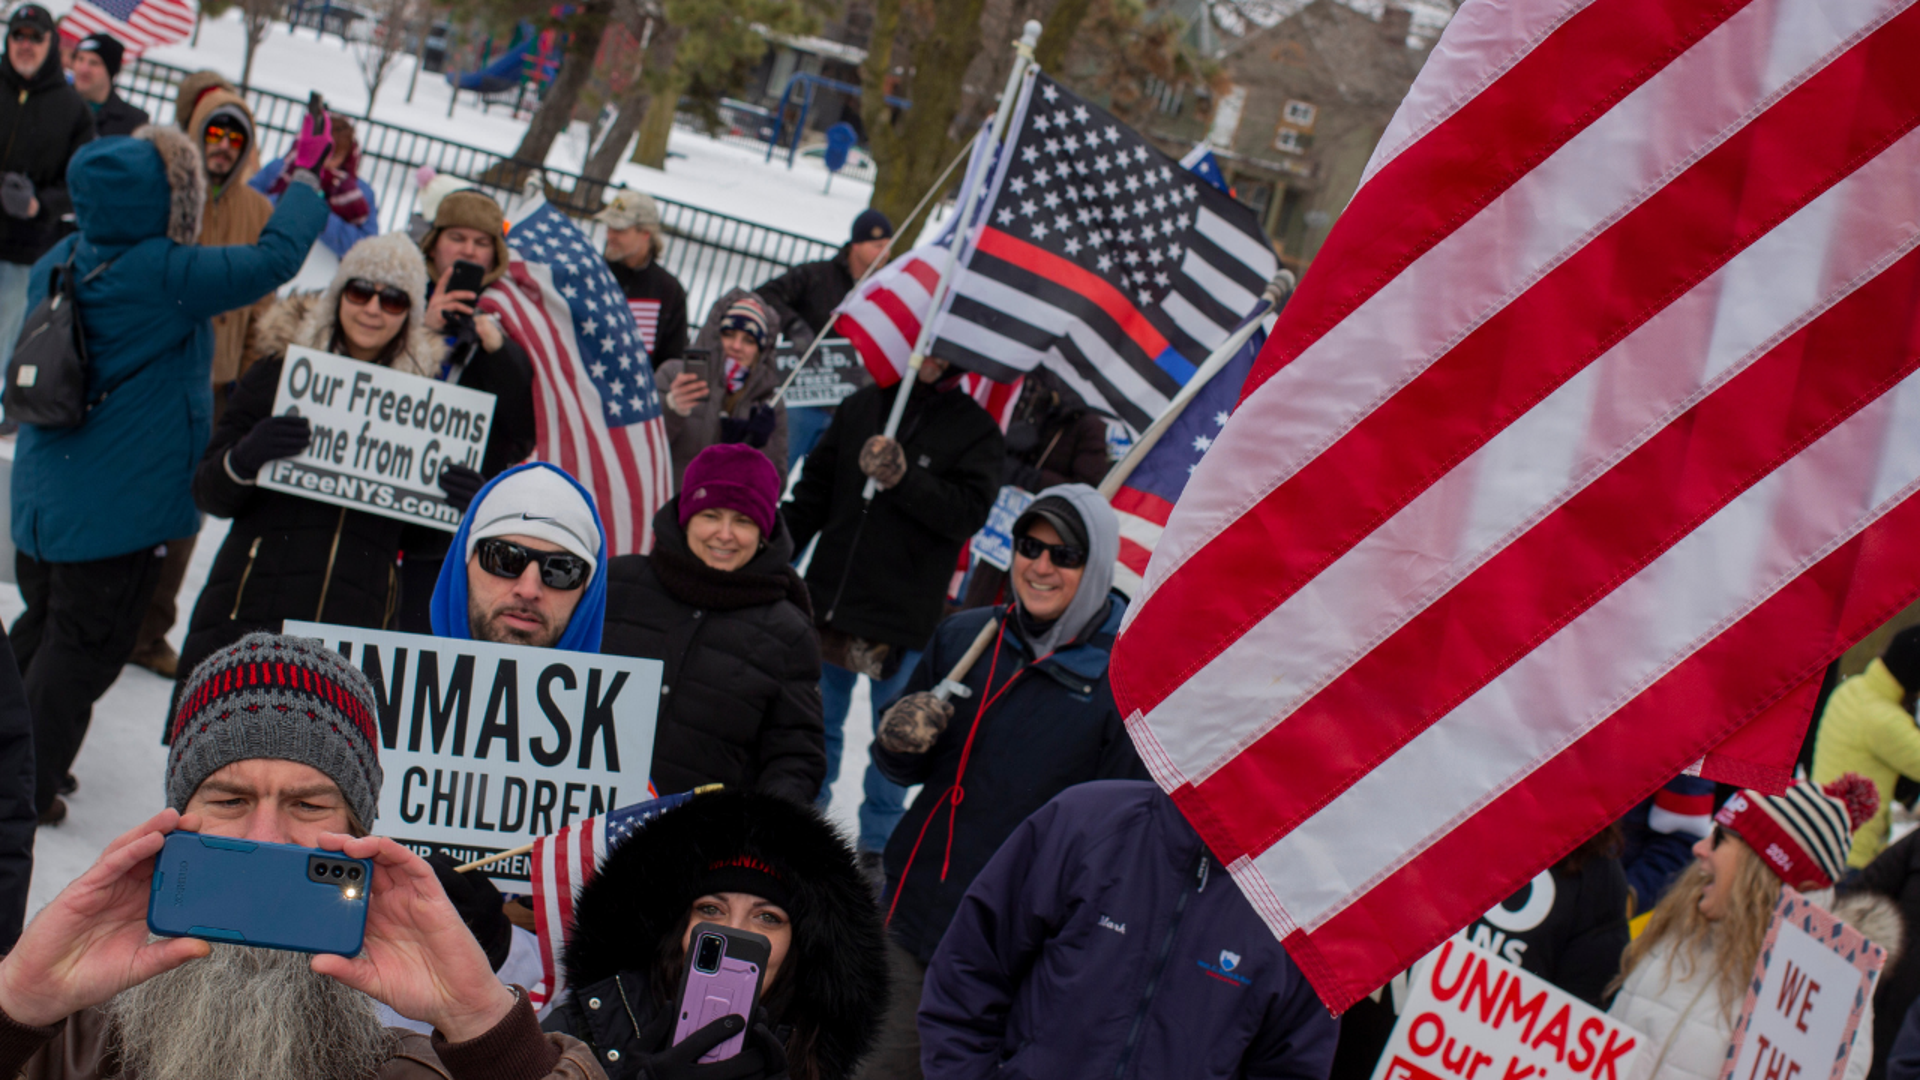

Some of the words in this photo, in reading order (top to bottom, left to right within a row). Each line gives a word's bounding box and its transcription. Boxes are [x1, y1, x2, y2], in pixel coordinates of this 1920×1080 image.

[288, 357, 344, 407] Our
[348, 370, 486, 444] Freedoms
[354, 420, 414, 481] from
[273, 462, 461, 524] FreeNYS.com
[335, 640, 631, 773] NMASK
[1430, 939, 1636, 1080] UNMASK
[1776, 959, 1821, 1035] WE
[1408, 1011, 1493, 1080] Our
